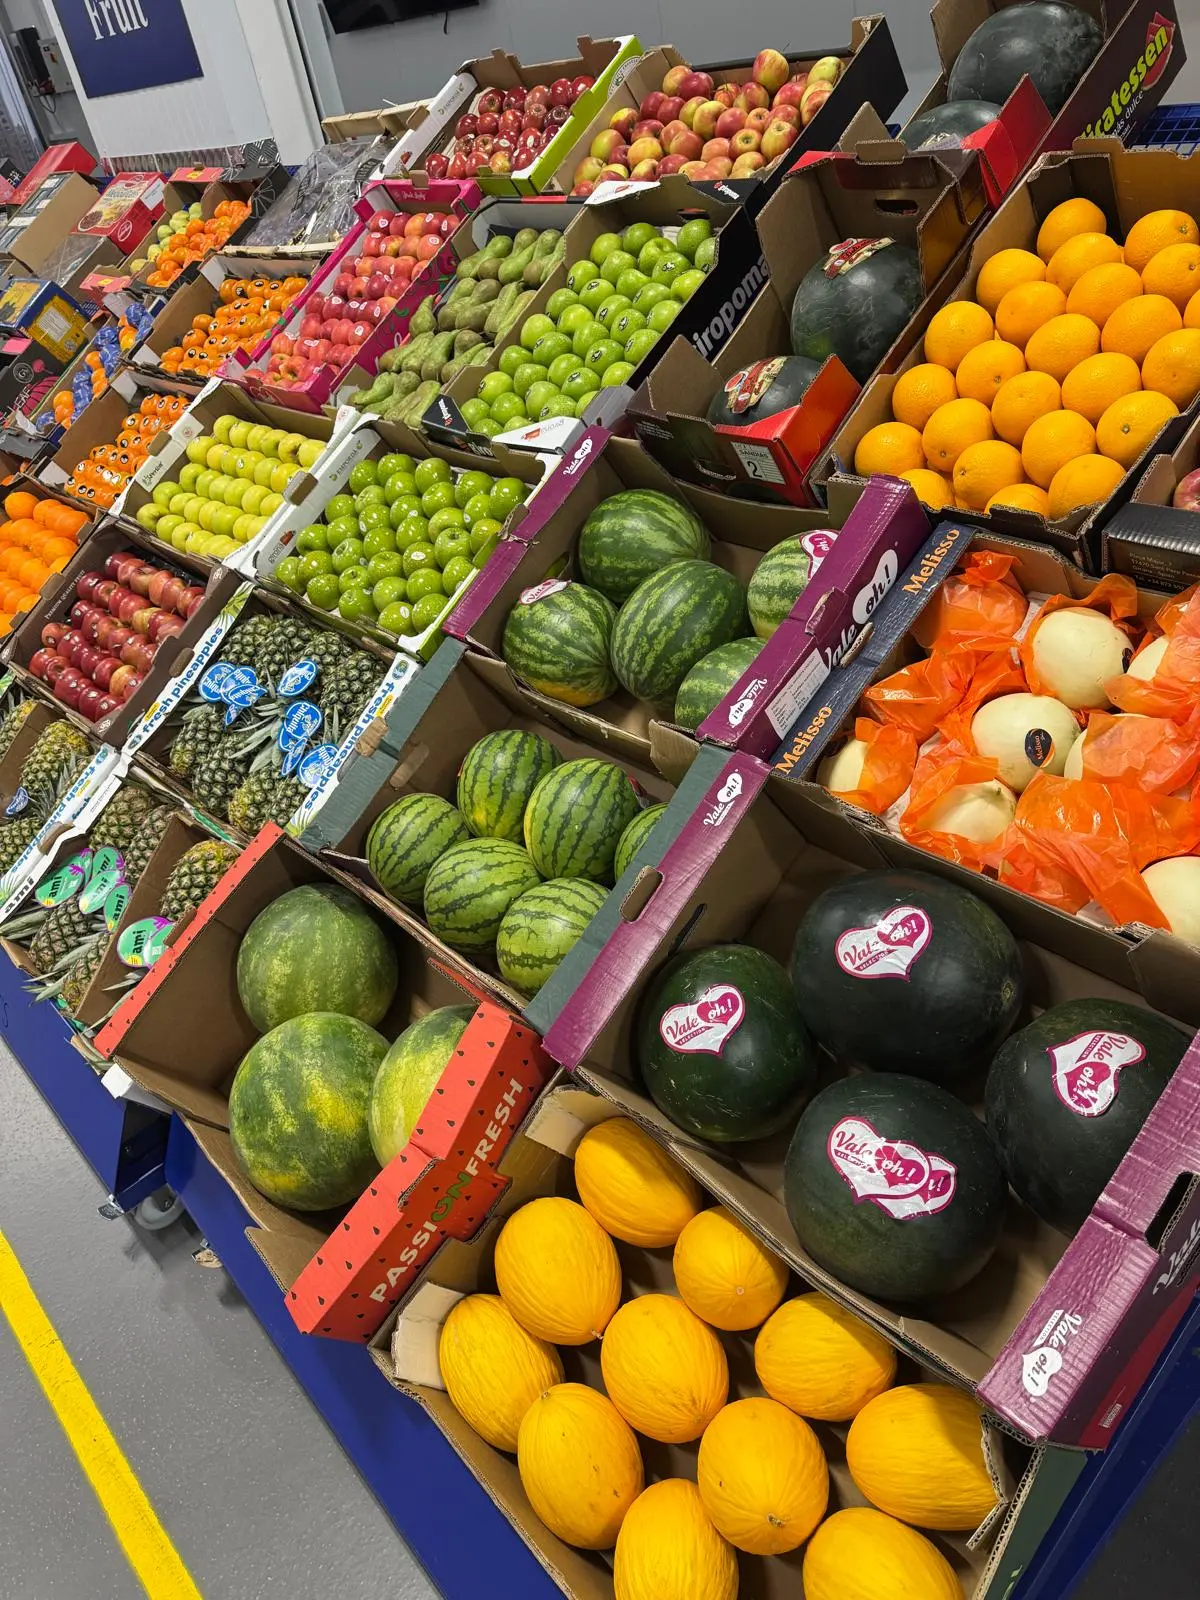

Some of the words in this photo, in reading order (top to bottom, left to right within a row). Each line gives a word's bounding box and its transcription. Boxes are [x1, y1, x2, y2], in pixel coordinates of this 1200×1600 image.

[84, 0, 148, 40] Fruit
[1080, 26, 1168, 139] icatessen
[1125, 90, 1144, 119] dulce
[694, 254, 770, 357] iropoma
[467, 441, 494, 456] giro
[747, 460, 763, 478] 2
[902, 529, 960, 595] Melisso
[865, 563, 891, 615] oh!
[142, 697, 173, 733] fresh
[171, 627, 223, 699] pineapples
[748, 678, 768, 700] Vale
[286, 702, 311, 733] Chiquita
[361, 681, 395, 725] fresh
[732, 702, 745, 720] oh!
[319, 746, 336, 766] quita
[774, 706, 833, 775] Melisso
[65, 765, 96, 802] fresh
[304, 724, 364, 810] pineapples
[703, 802, 725, 826] Vale
[726, 778, 740, 797] oh!
[4, 877, 35, 914] ami
[49, 875, 62, 898] ami
[113, 894, 125, 921] ami
[132, 929, 146, 954] ami
[859, 950, 889, 971] SELECTION
[666, 1015, 700, 1040] Vale
[708, 998, 733, 1019] oh!
[679, 1026, 706, 1045] SELECTION
[1082, 1034, 1102, 1058] SELECTION
[1093, 1035, 1128, 1061] Vale
[1072, 1066, 1096, 1100] oh!
[882, 1158, 917, 1181] oh!
[1039, 1310, 1061, 1343] SELECTION
[1050, 1312, 1083, 1348] Vale
[1027, 1353, 1048, 1388] oh!
